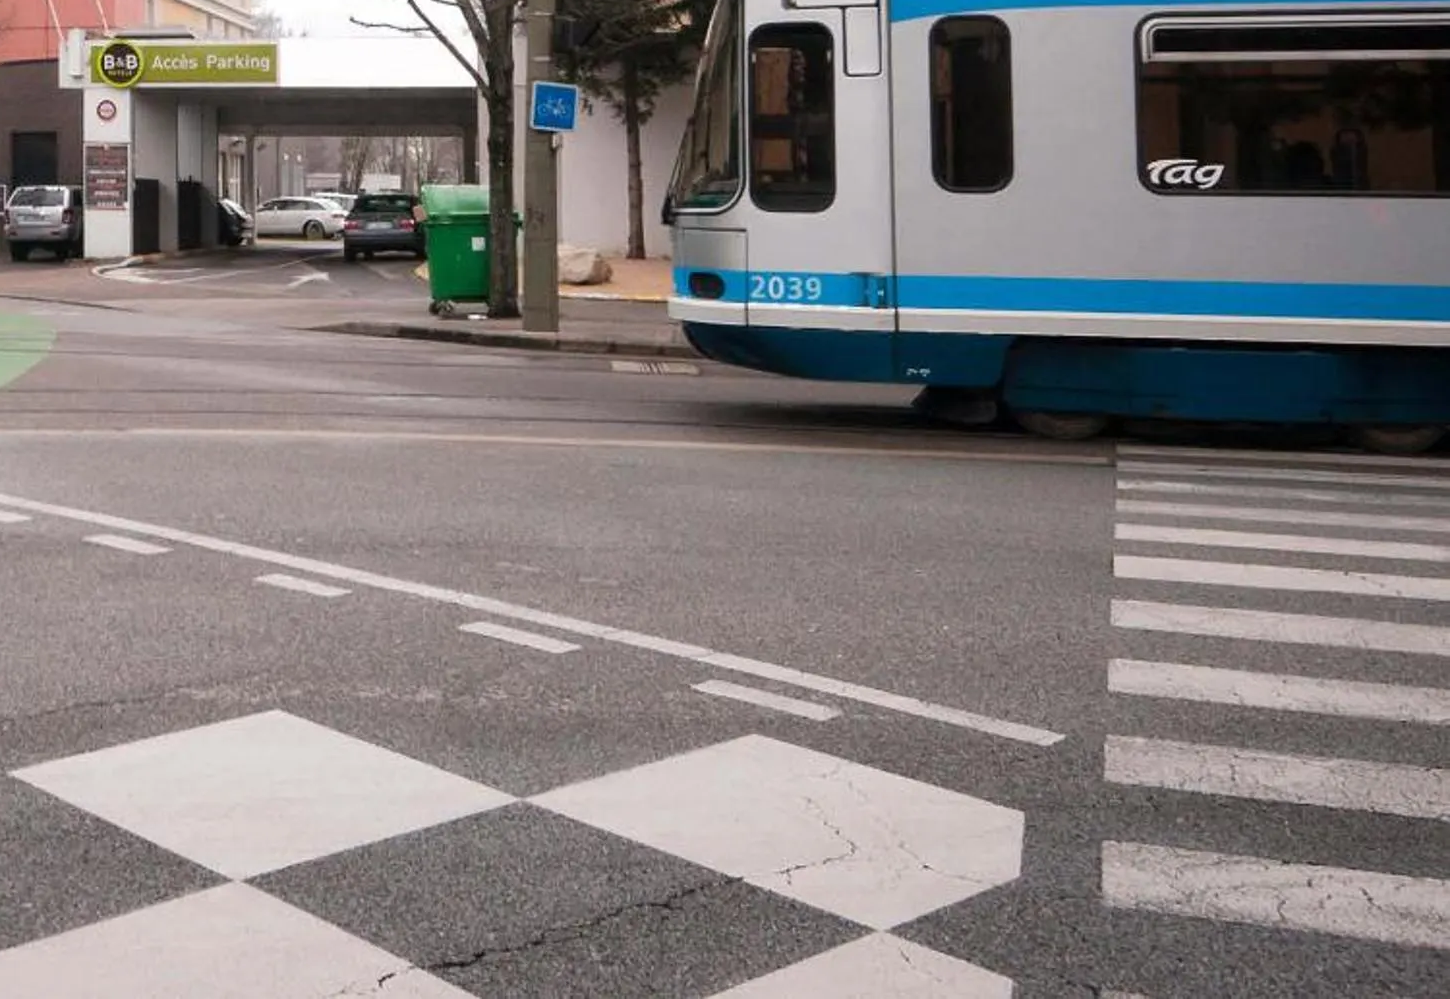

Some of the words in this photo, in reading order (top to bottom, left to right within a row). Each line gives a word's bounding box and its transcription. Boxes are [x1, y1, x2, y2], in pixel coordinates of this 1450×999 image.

[103, 54, 138, 70] B&B
[152, 54, 198, 70] Accès
[206, 54, 270, 72] Parking
[750, 275, 822, 300] 2039
